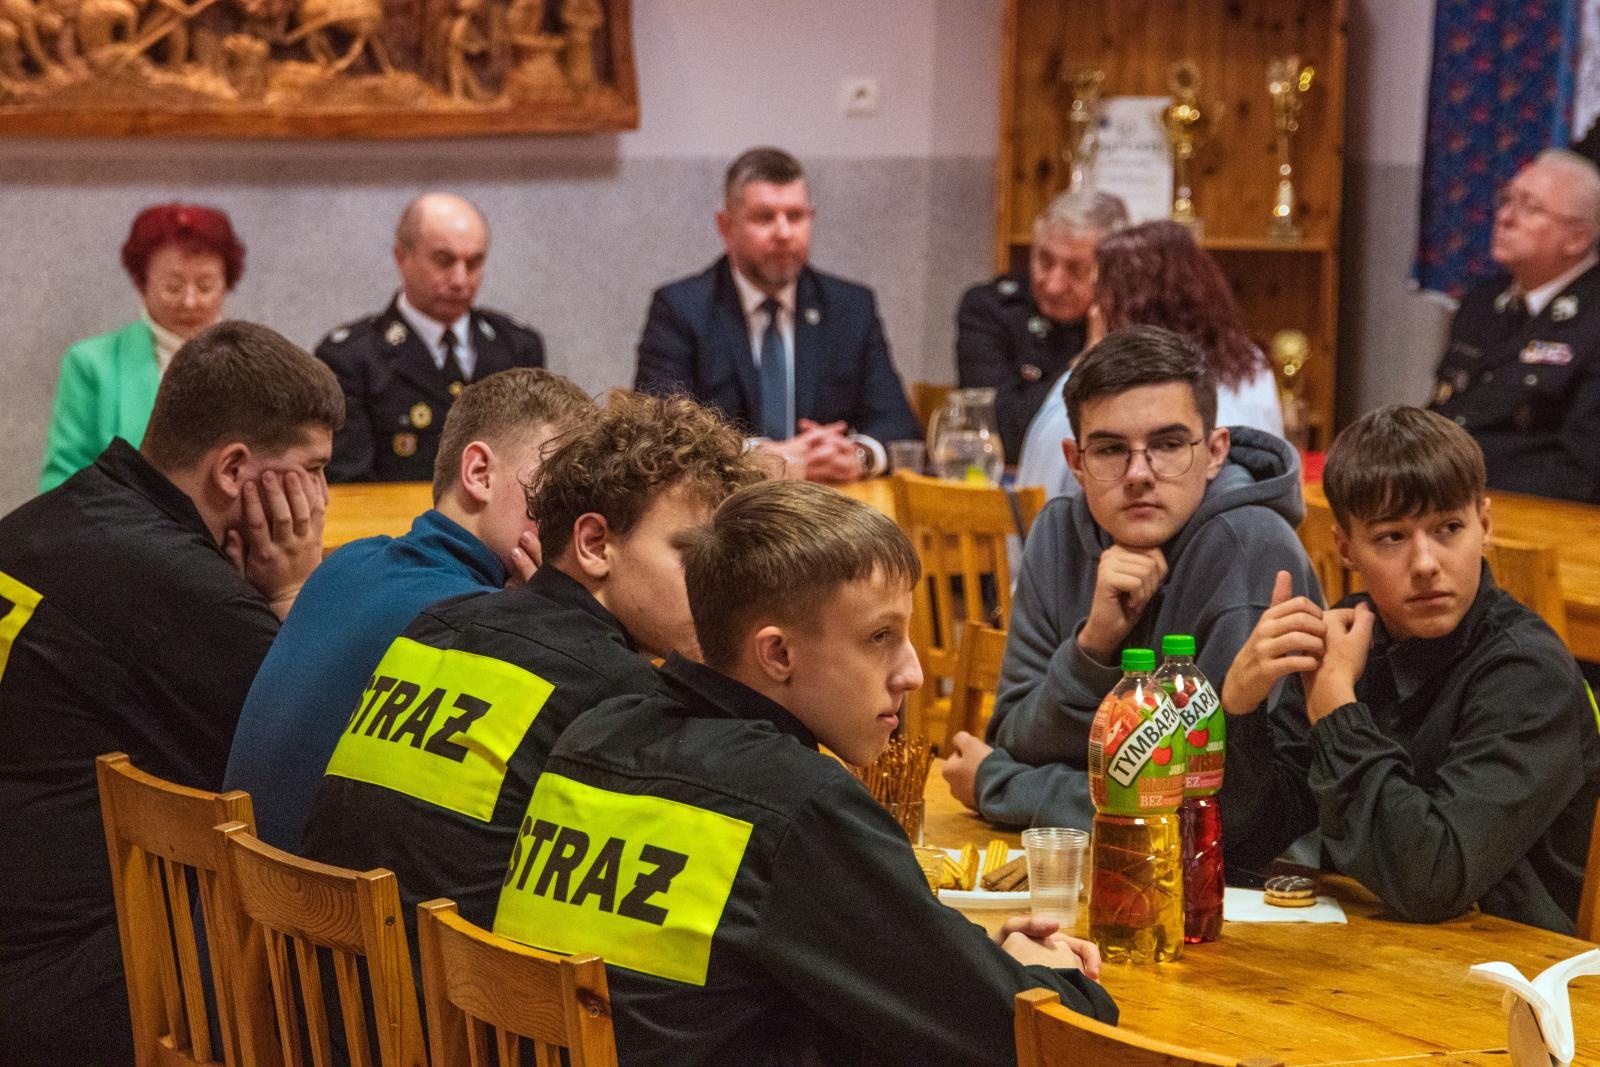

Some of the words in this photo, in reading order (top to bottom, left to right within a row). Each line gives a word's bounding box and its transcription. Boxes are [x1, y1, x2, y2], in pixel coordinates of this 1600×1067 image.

[1179, 685, 1218, 731] BARK
[1113, 701, 1179, 777] TYMBARK
[1184, 775, 1200, 788] EZ
[1140, 795, 1164, 807] BEZ
